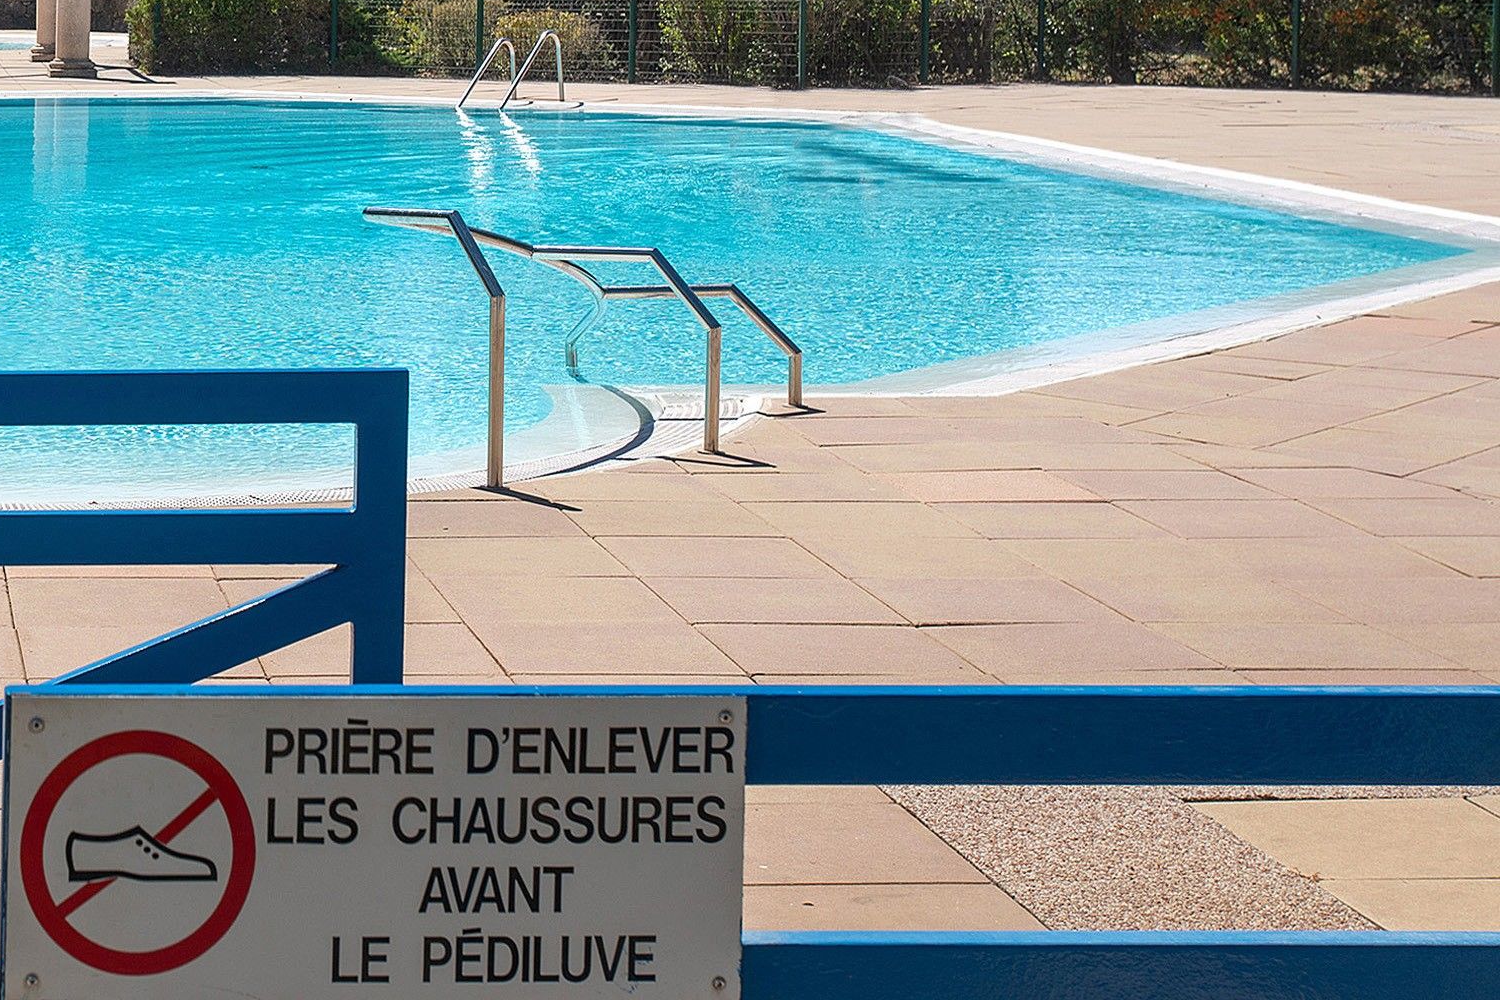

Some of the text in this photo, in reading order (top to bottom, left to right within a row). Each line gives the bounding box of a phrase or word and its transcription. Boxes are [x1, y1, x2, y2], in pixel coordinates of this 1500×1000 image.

[466, 726, 735, 775] D'ENLEVER
[266, 795, 728, 846] LES CHAUSSURES
[418, 865, 575, 914] AVANT
[331, 927, 657, 984] LE PÉDILUVE
